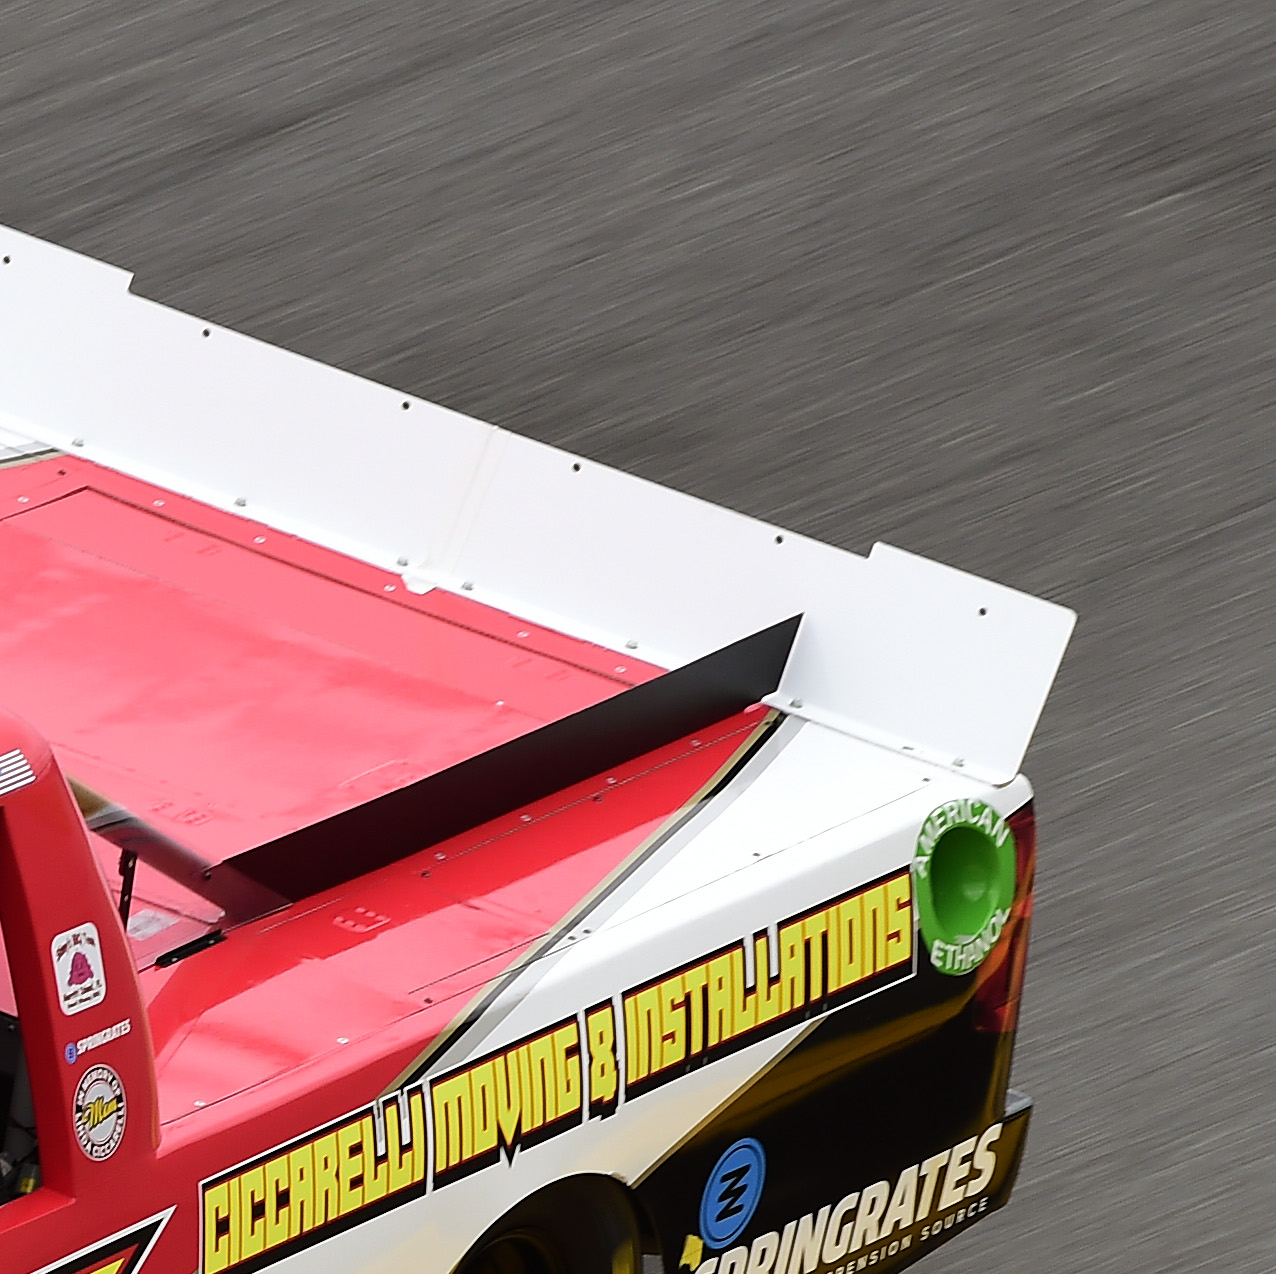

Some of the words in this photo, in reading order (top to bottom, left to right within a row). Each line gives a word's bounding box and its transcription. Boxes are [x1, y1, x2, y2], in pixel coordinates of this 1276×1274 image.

[915, 798, 1011, 878] AMERICAN
[931, 907, 1011, 970] ETHANOL
[435, 1022, 580, 1150] MOVING
[588, 1005, 618, 1103] &
[626, 872, 912, 1084] INSTALLATIONS
[919, 1196, 989, 1242] SOURCE
